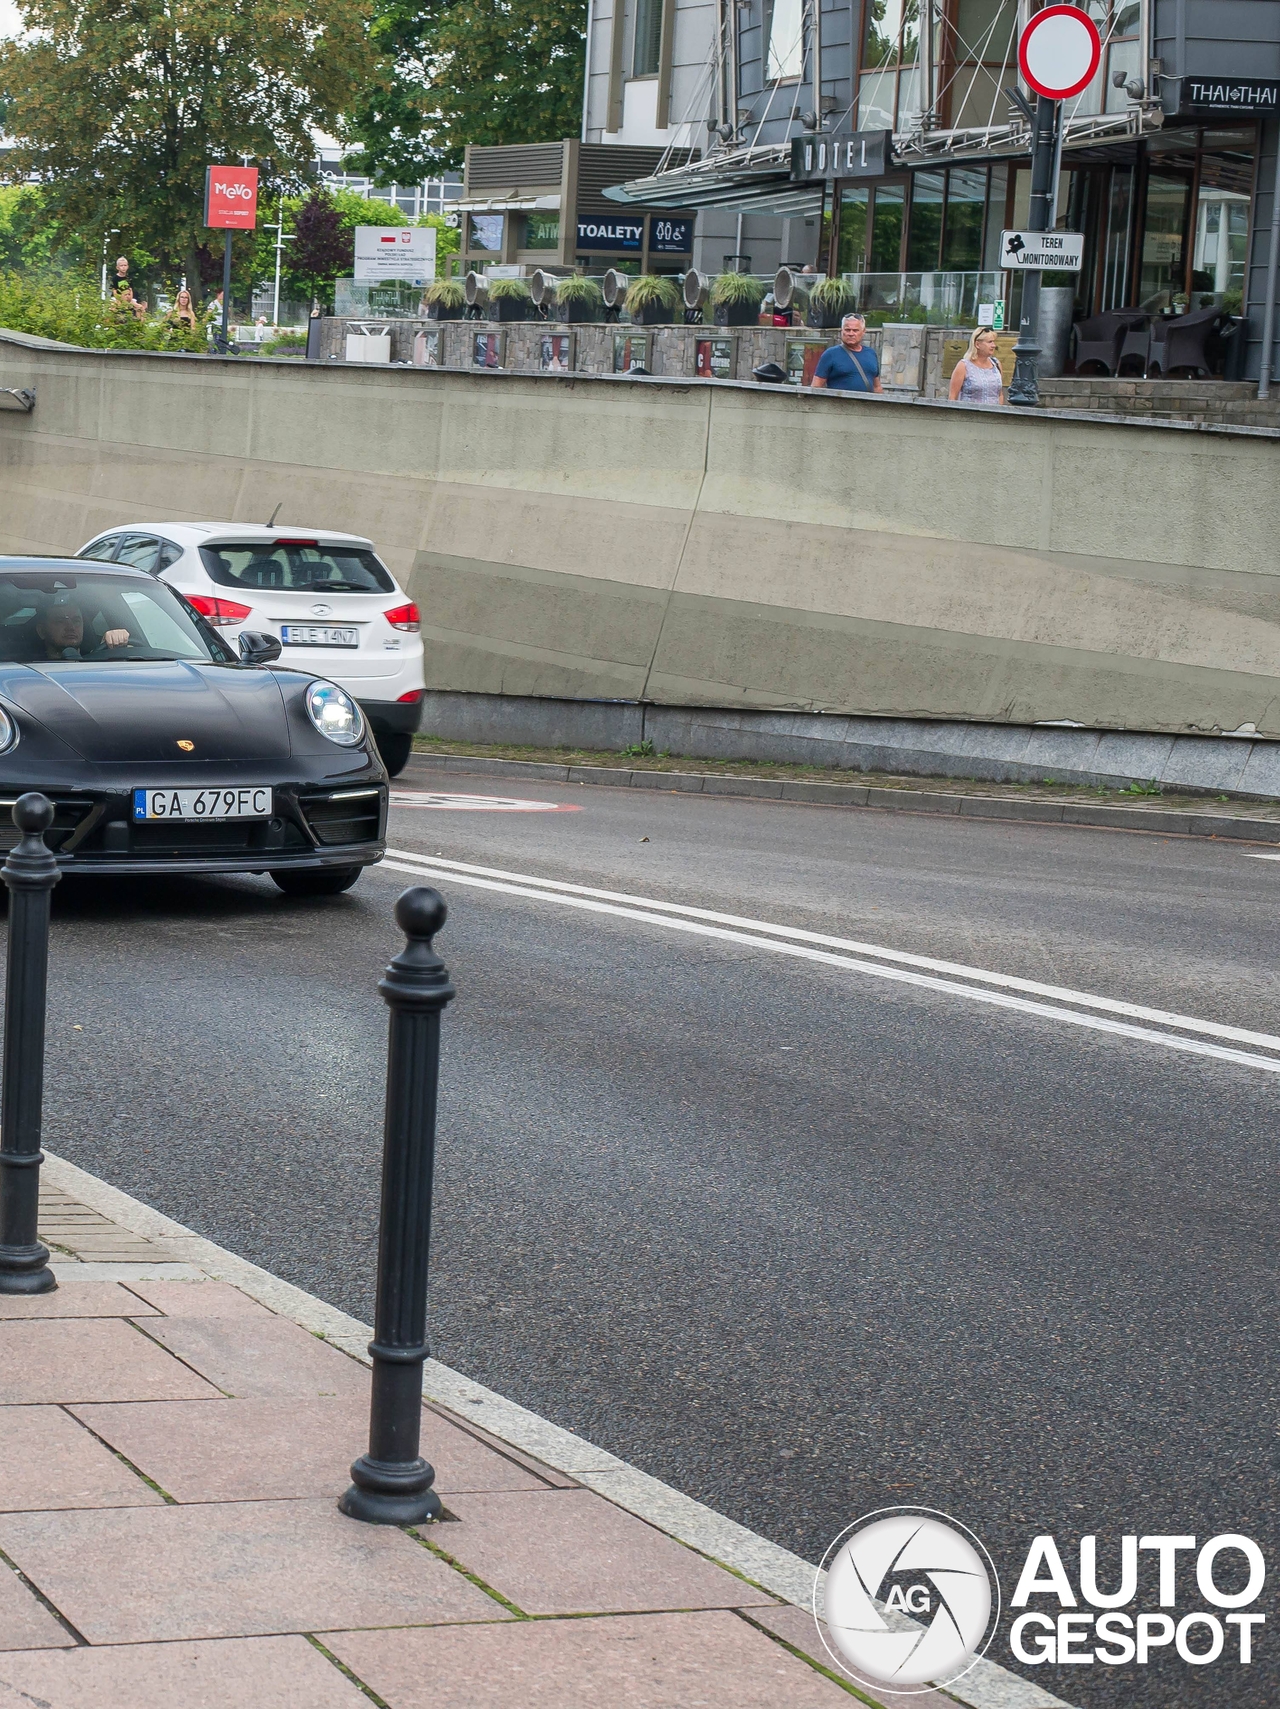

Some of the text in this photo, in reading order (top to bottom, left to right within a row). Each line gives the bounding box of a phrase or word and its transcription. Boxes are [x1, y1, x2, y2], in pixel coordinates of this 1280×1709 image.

[1190, 83, 1277, 104] THAI THAI
[805, 140, 868, 171] HOTEL
[537, 222, 559, 239] ATM
[577, 224, 643, 240] TOALETY
[1041, 236, 1064, 249] TEREN
[1022, 253, 1080, 267] MONITOROWANY
[291, 628, 317, 642] ELE
[151, 789, 267, 816] GA 679FC
[136, 807, 145, 815] PL
